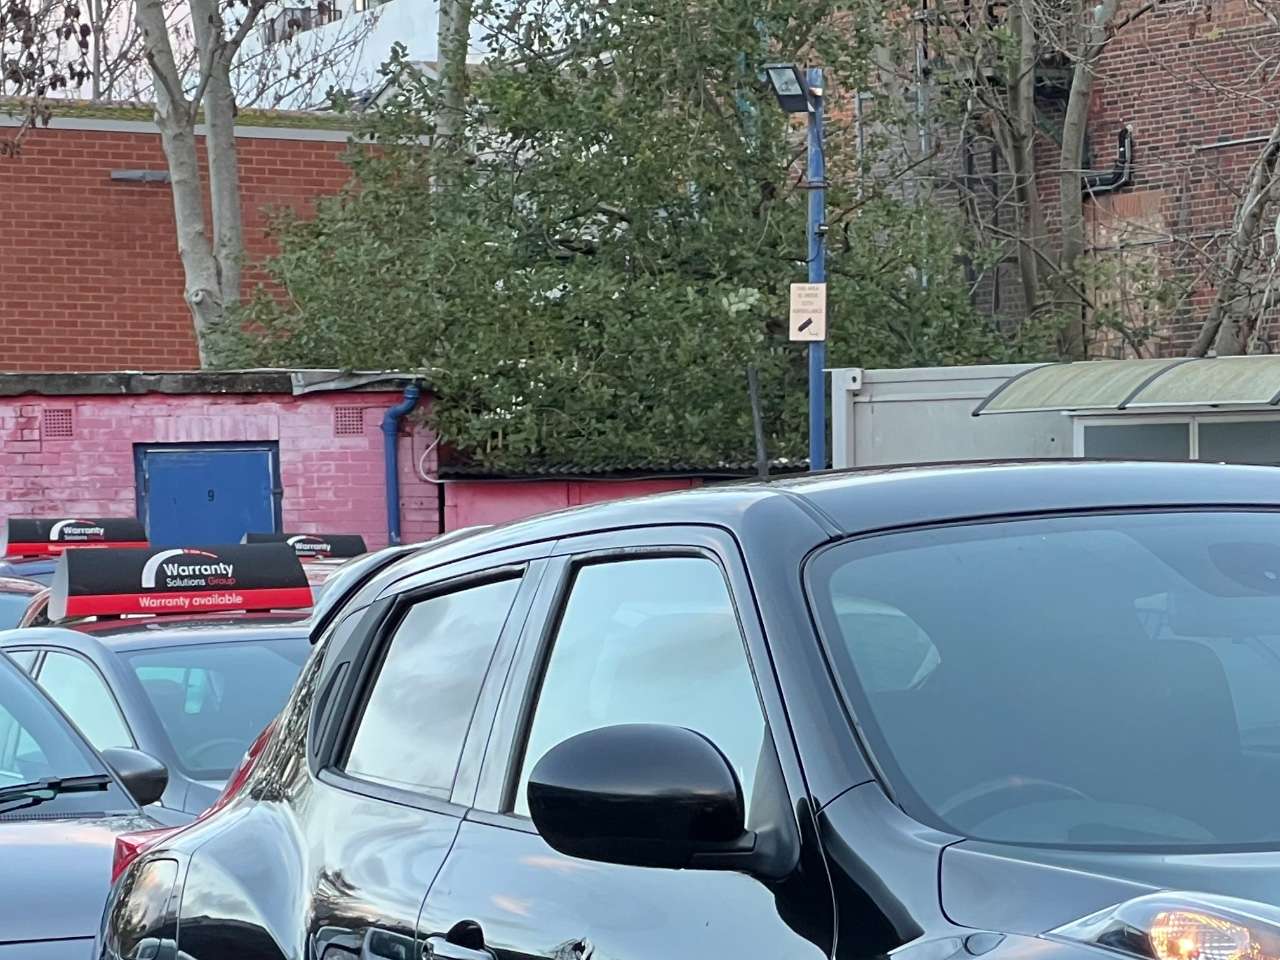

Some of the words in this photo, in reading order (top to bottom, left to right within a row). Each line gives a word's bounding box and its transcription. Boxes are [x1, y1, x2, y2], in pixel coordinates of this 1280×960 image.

[207, 489, 215, 502] 9
[63, 526, 105, 536] Warranty
[294, 542, 331, 552] Warranty
[163, 562, 233, 578] Warranty
[166, 577, 206, 588] Solutions
[207, 577, 237, 586] Group
[139, 596, 190, 608] Warranty
[192, 593, 243, 606] available
